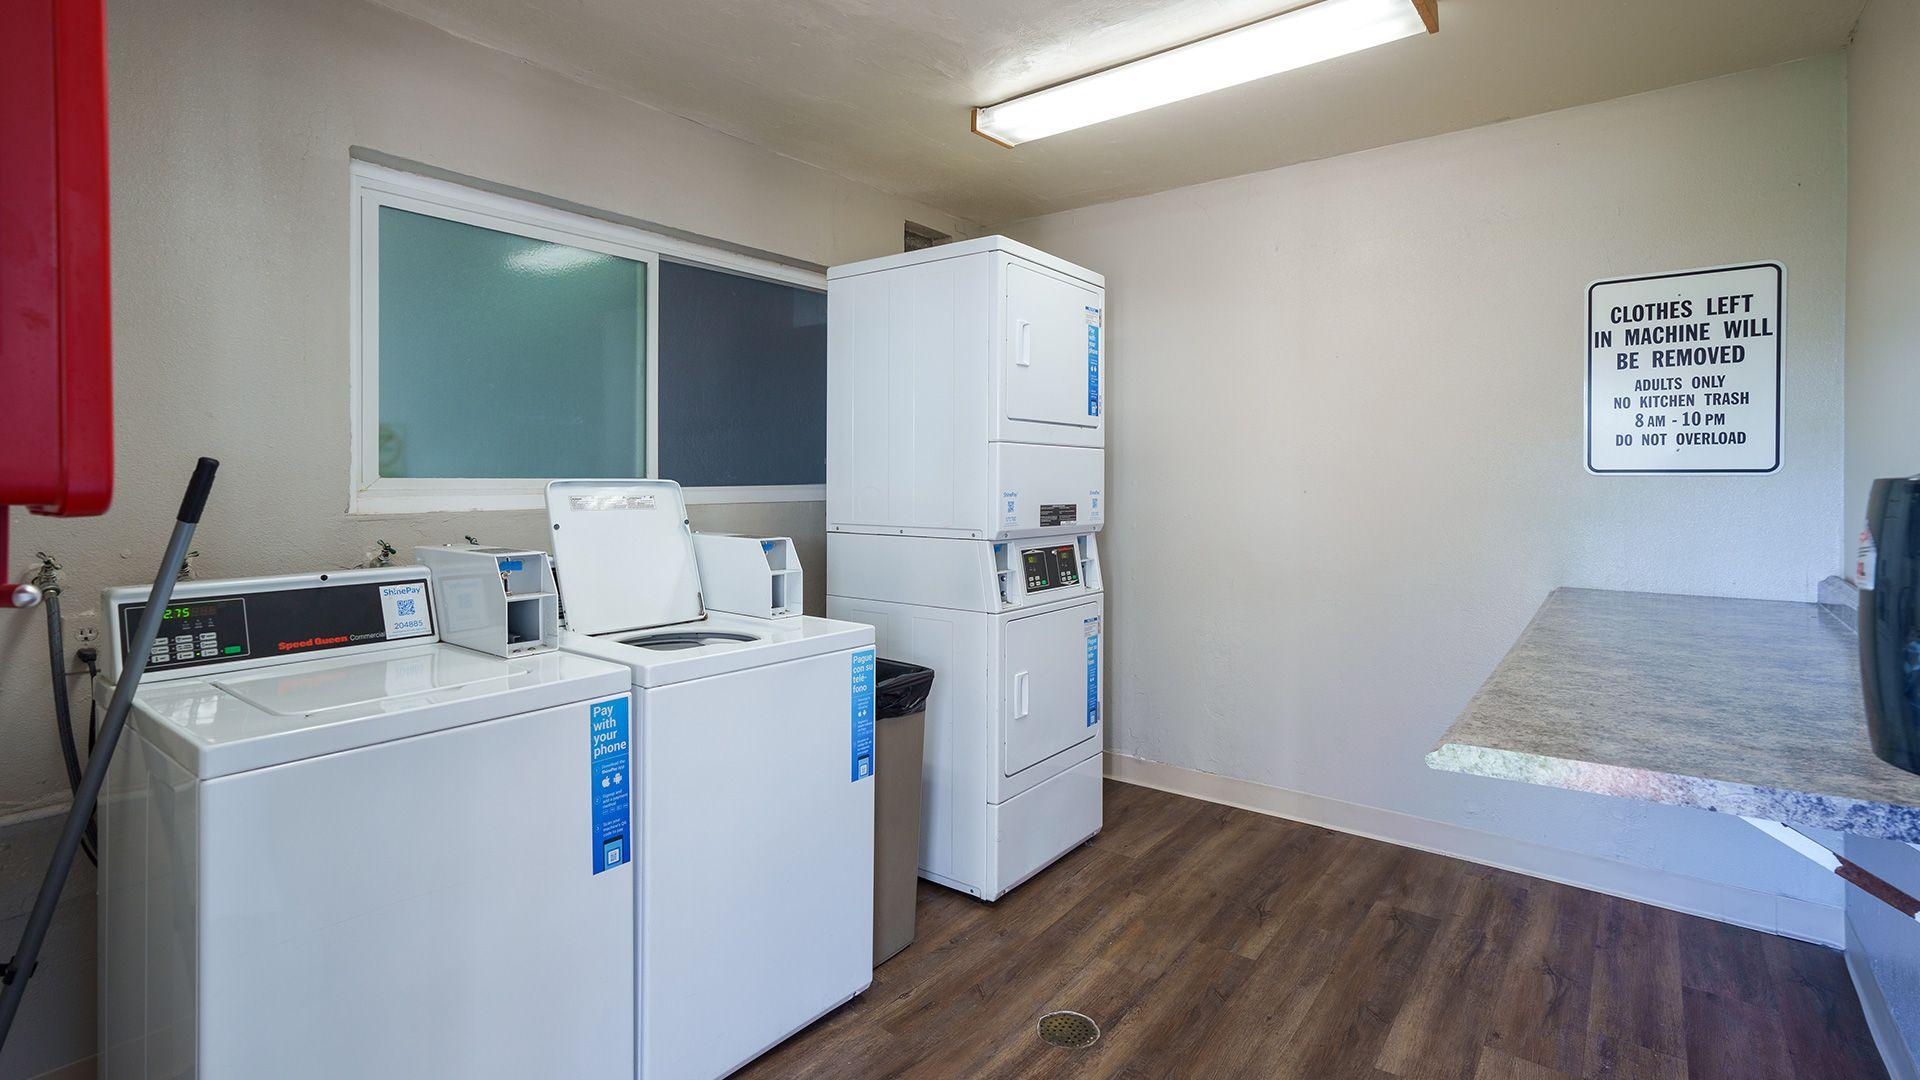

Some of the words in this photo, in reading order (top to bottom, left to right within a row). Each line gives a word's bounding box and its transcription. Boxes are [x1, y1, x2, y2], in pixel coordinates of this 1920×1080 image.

[1611, 300, 1693, 324] CLOTHES
[1707, 294, 1754, 315] LEFT
[1594, 331, 1612, 348] IN
[1625, 322, 1710, 346] MACHINE
[1724, 318, 1773, 339] WILL
[1616, 352, 1640, 370] BE
[1652, 345, 1745, 368] REMOVED
[1634, 377, 1683, 391] ADULTS
[1691, 375, 1726, 389] ONLY
[1613, 397, 1631, 409] NO
[1640, 394, 1695, 408] KITCHEN
[1704, 391, 1750, 406] TRASH
[1635, 413, 1644, 427] 8
[1647, 415, 1666, 427] AM
[1682, 411, 1701, 426] 10
[1705, 413, 1725, 425] PM
[1616, 433, 1632, 446] DO
[1642, 433, 1667, 446] NOT
[1676, 431, 1747, 445] OVERLOAD
[383, 586, 421, 597] ShinePay
[163, 607, 190, 619] 2.75
[394, 619, 424, 630] 204885
[278, 639, 313, 651] Speed
[315, 635, 348, 646] Queen
[593, 705, 614, 717] Pay
[593, 717, 616, 731] with
[593, 730, 618, 746] your
[593, 741, 627, 759] phone
